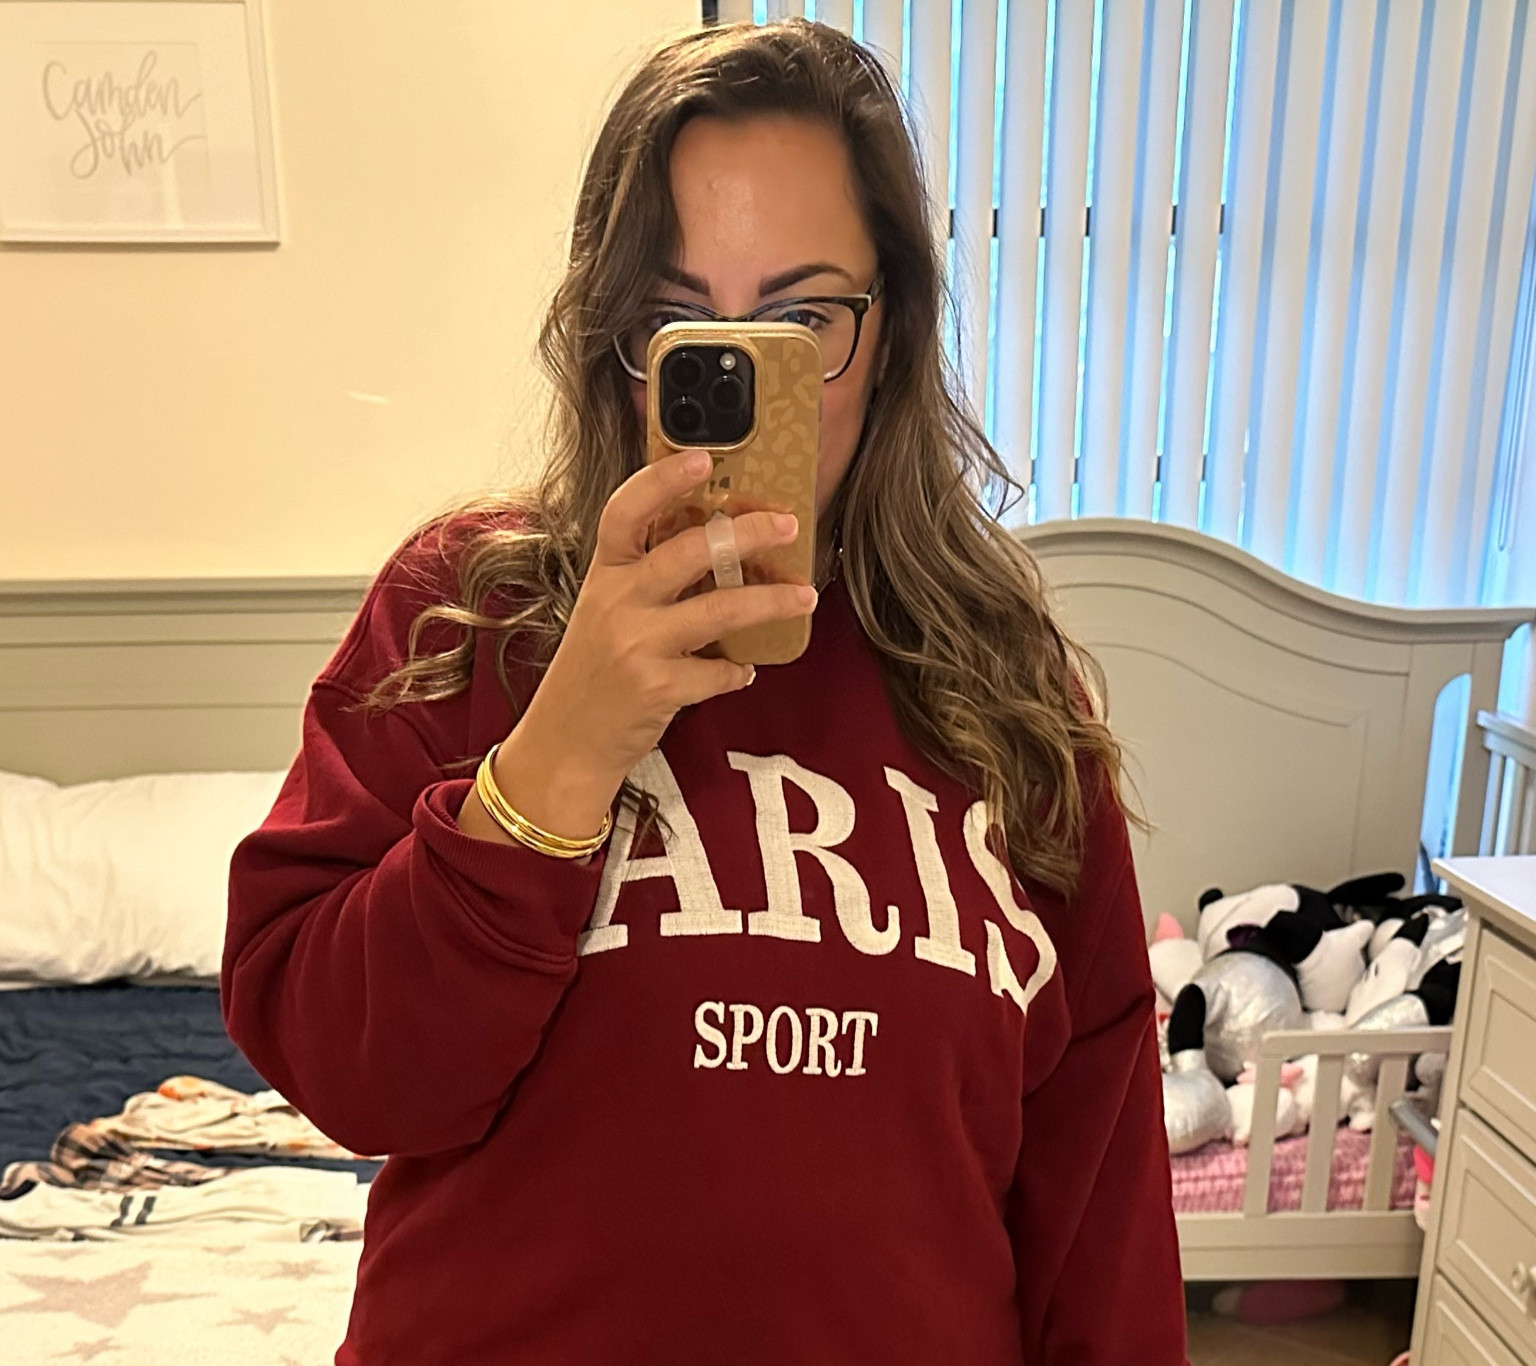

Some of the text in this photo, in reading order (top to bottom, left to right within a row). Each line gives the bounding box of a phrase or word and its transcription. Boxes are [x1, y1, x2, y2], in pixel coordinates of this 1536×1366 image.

[42, 49, 202, 120] Camden
[70, 108, 207, 180] John
[576, 745, 1057, 1016] ARIS
[693, 1001, 878, 1077] SPORT
